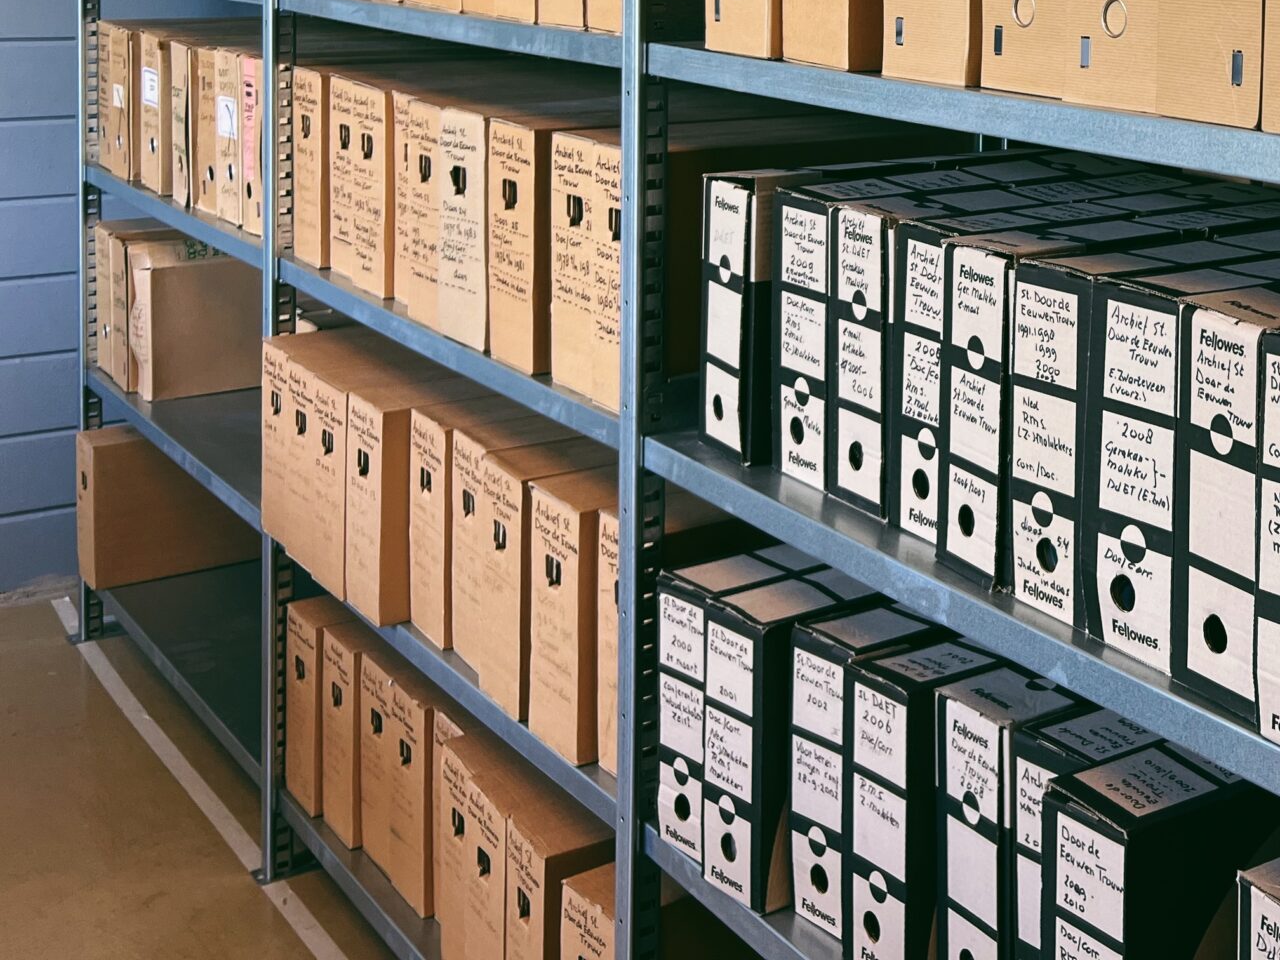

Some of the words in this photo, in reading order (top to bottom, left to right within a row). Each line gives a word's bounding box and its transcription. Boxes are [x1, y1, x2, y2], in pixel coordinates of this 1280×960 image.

[715, 195, 739, 215] Fellowes
[845, 228, 872, 245] Fellowes
[910, 244, 940, 274] Archief
[960, 263, 994, 287] Fellowes
[913, 294, 940, 316] Trouw
[1021, 289, 1032, 301] St.
[1052, 311, 1075, 328] Trouw
[1112, 305, 1148, 335] Archief
[1200, 328, 1244, 357] Fellowes
[1129, 349, 1158, 368] Trouw
[1197, 350, 1231, 380] Archief
[960, 373, 985, 398] Archief
[1121, 423, 1153, 444] 2008
[788, 451, 816, 471] Fellowes
[1023, 579, 1063, 609] Fellowes
[1112, 618, 1158, 649] Fellowes
[953, 719, 988, 749] Fellowes
[665, 824, 696, 851] Fellowes
[1062, 825, 1085, 850] Door
[1088, 840, 1100, 859] de
[711, 864, 743, 893] Fellowes
[1060, 843, 1095, 876] Eeuwen
[1096, 864, 1124, 894] Trouw
[801, 897, 836, 926] Fellowes
[1063, 894, 1085, 913] 2010
